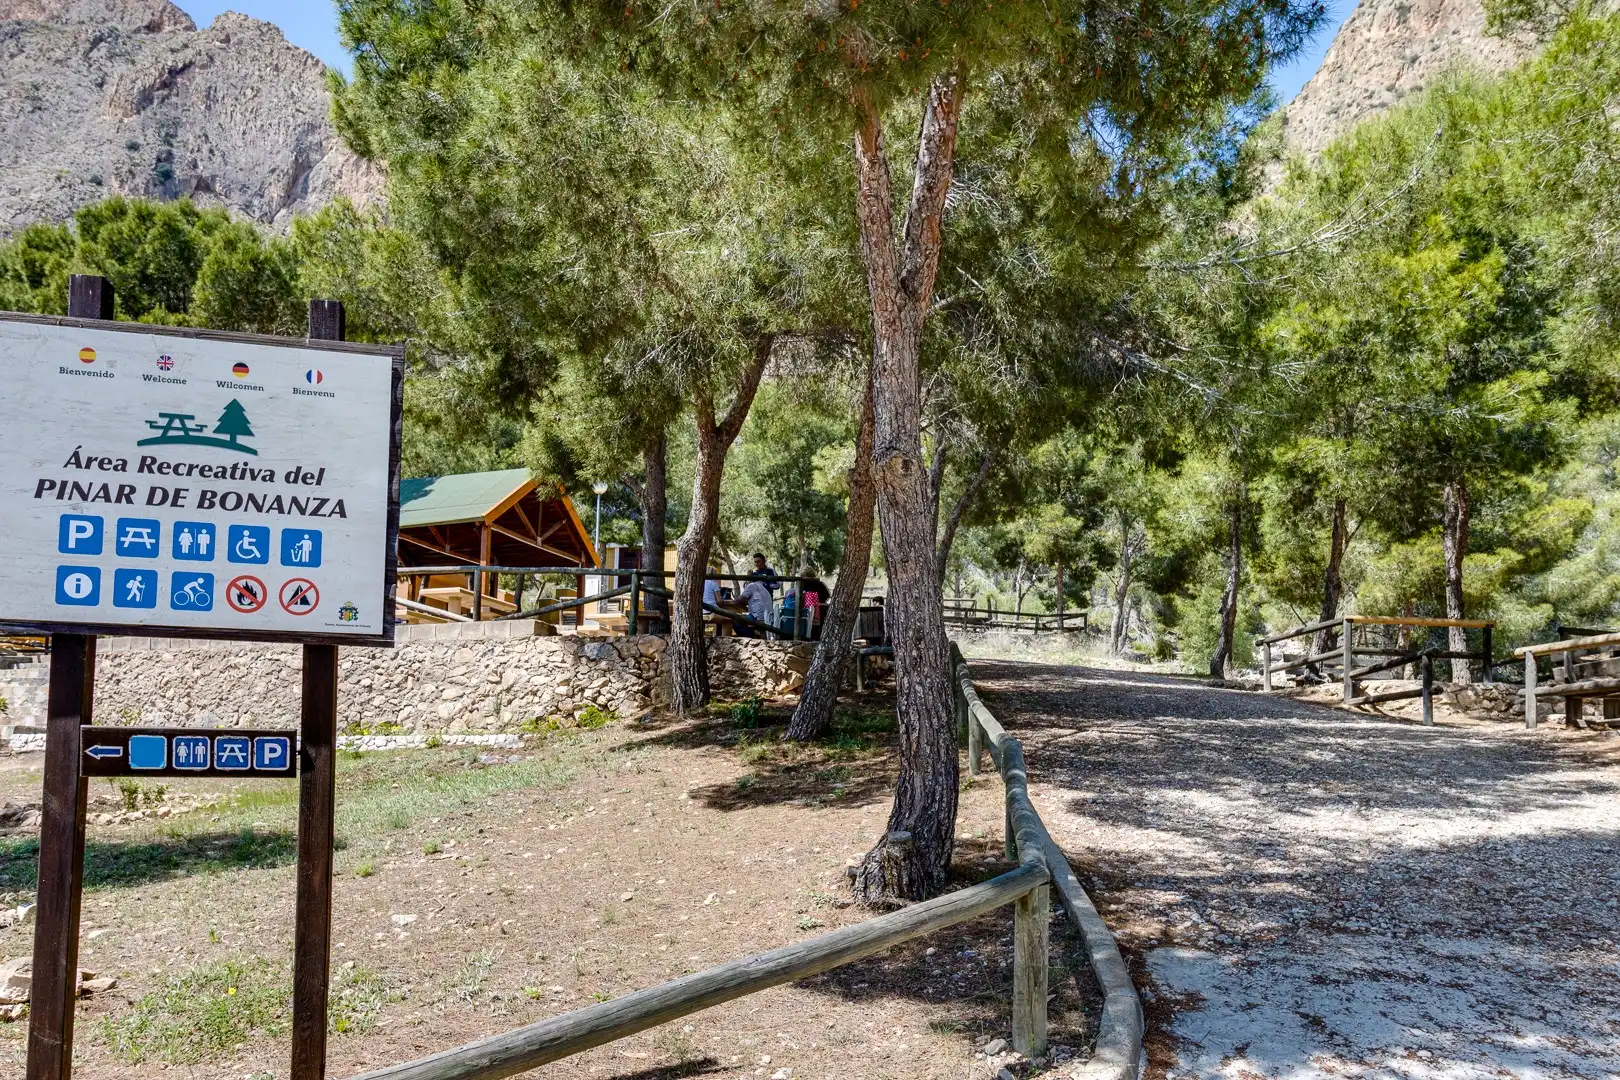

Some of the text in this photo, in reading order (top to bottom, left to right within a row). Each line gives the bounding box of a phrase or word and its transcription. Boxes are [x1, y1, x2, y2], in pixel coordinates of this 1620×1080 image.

[59, 366, 115, 379] Bienvenido
[142, 374, 187, 385] Welcome
[216, 380, 264, 392] Wilcomen
[292, 387, 335, 398] Bienvenu
[63, 445, 325, 486] Área Recreativa del
[34, 478, 348, 519] PINAR DE BONANZA
[68, 519, 94, 549] P
[264, 742, 282, 765] P
